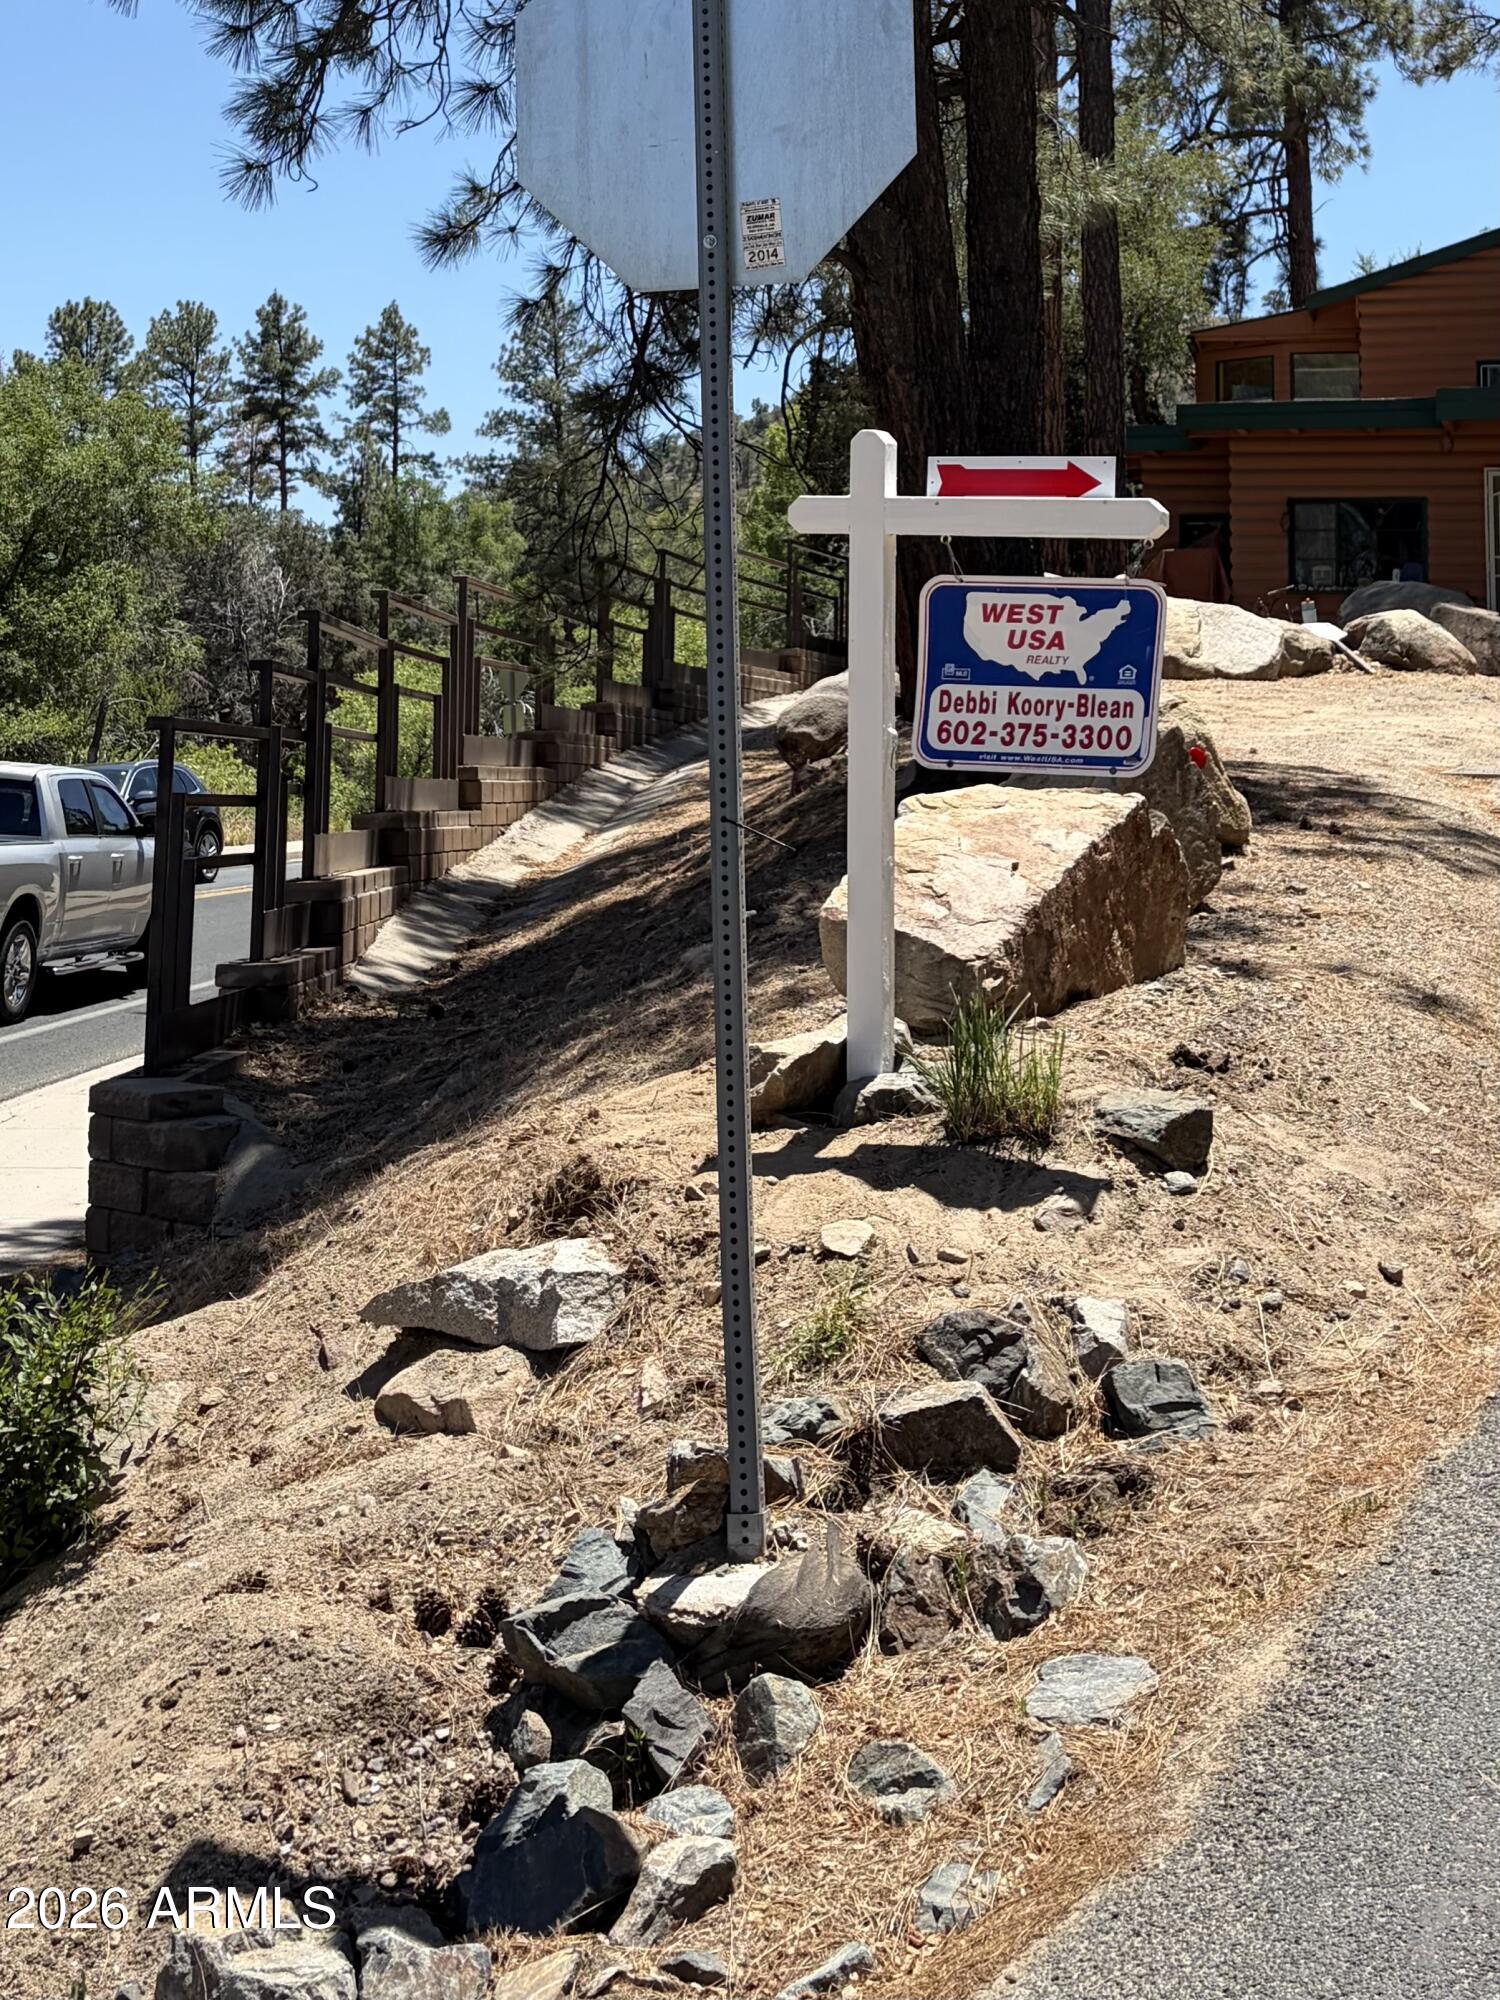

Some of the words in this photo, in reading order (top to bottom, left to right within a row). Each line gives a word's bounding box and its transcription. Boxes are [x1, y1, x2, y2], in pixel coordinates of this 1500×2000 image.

[746, 212, 776, 222] ZUMAR
[748, 248, 778, 263] 2014
[981, 603, 1064, 624] WEST
[1007, 629, 1065, 650] USA
[1026, 655, 1070, 665] REALTY
[938, 689, 997, 714] Debbi
[1007, 691, 1134, 722] Koory-Blean
[936, 719, 1132, 750] 602-375-3300
[979, 753, 997, 761] visit
[1001, 755, 1084, 764] www.WestUSA.com
